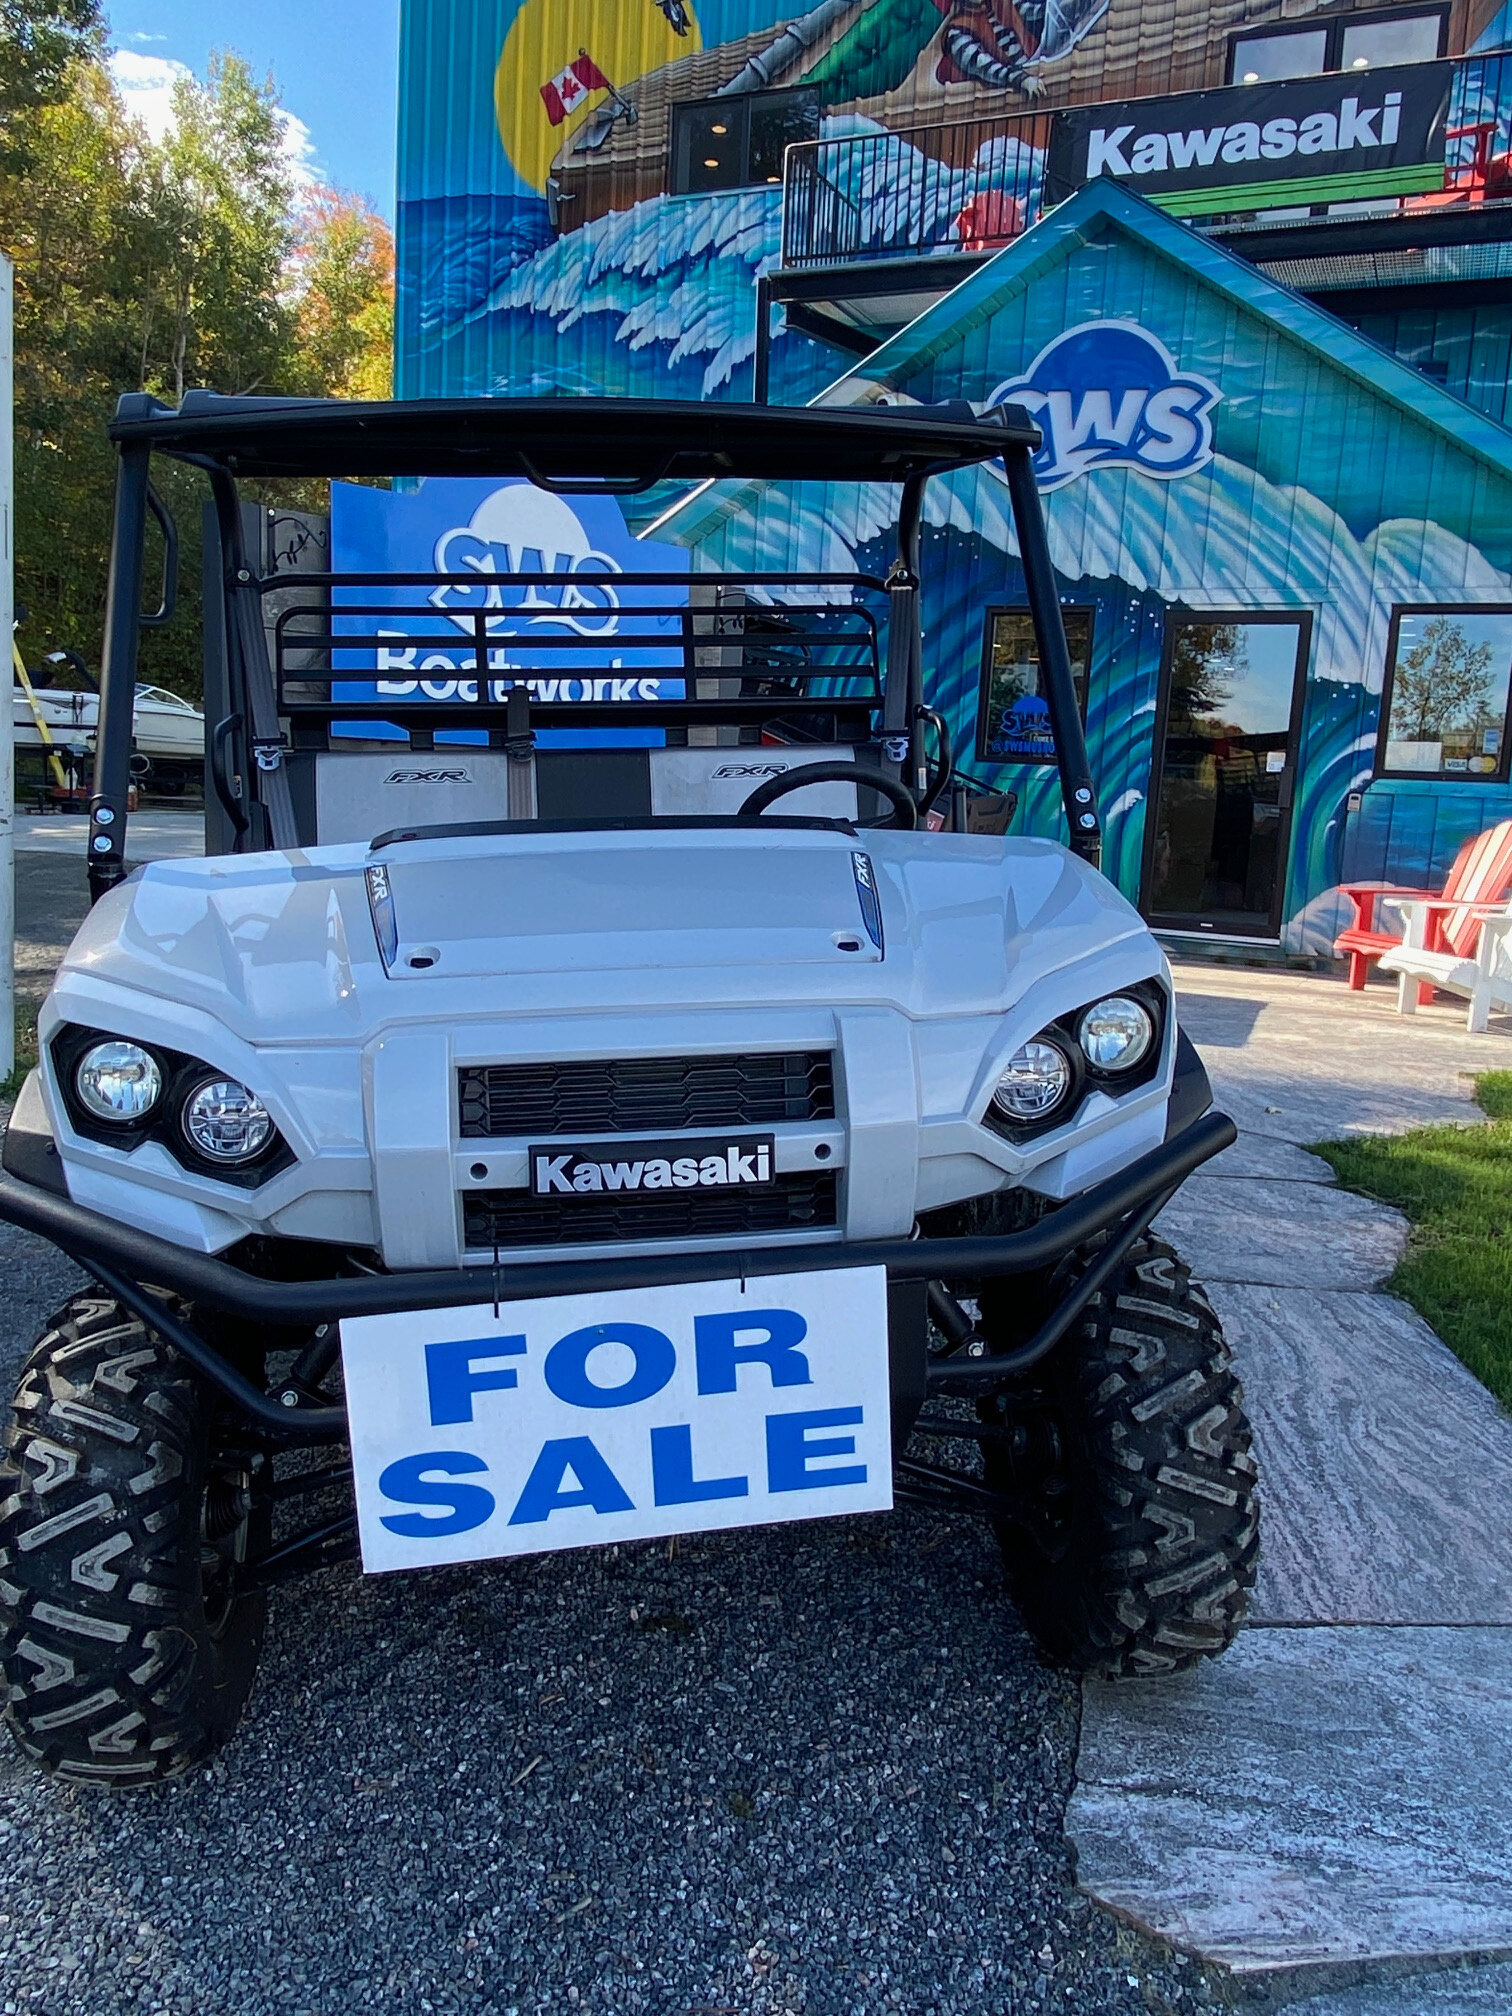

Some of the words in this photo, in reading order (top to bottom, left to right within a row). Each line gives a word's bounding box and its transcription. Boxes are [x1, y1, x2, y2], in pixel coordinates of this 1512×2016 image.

[1086, 91, 1402, 179] Kawasaki
[376, 630, 661, 703] Boatworks
[388, 770, 466, 784] FXR
[717, 765, 788, 778] FXR
[370, 866, 389, 901] FXR
[854, 852, 871, 889] FXR
[536, 1144, 770, 1194] Kawasaki
[424, 1308, 815, 1426] FOR
[378, 1405, 868, 1539] SALE
